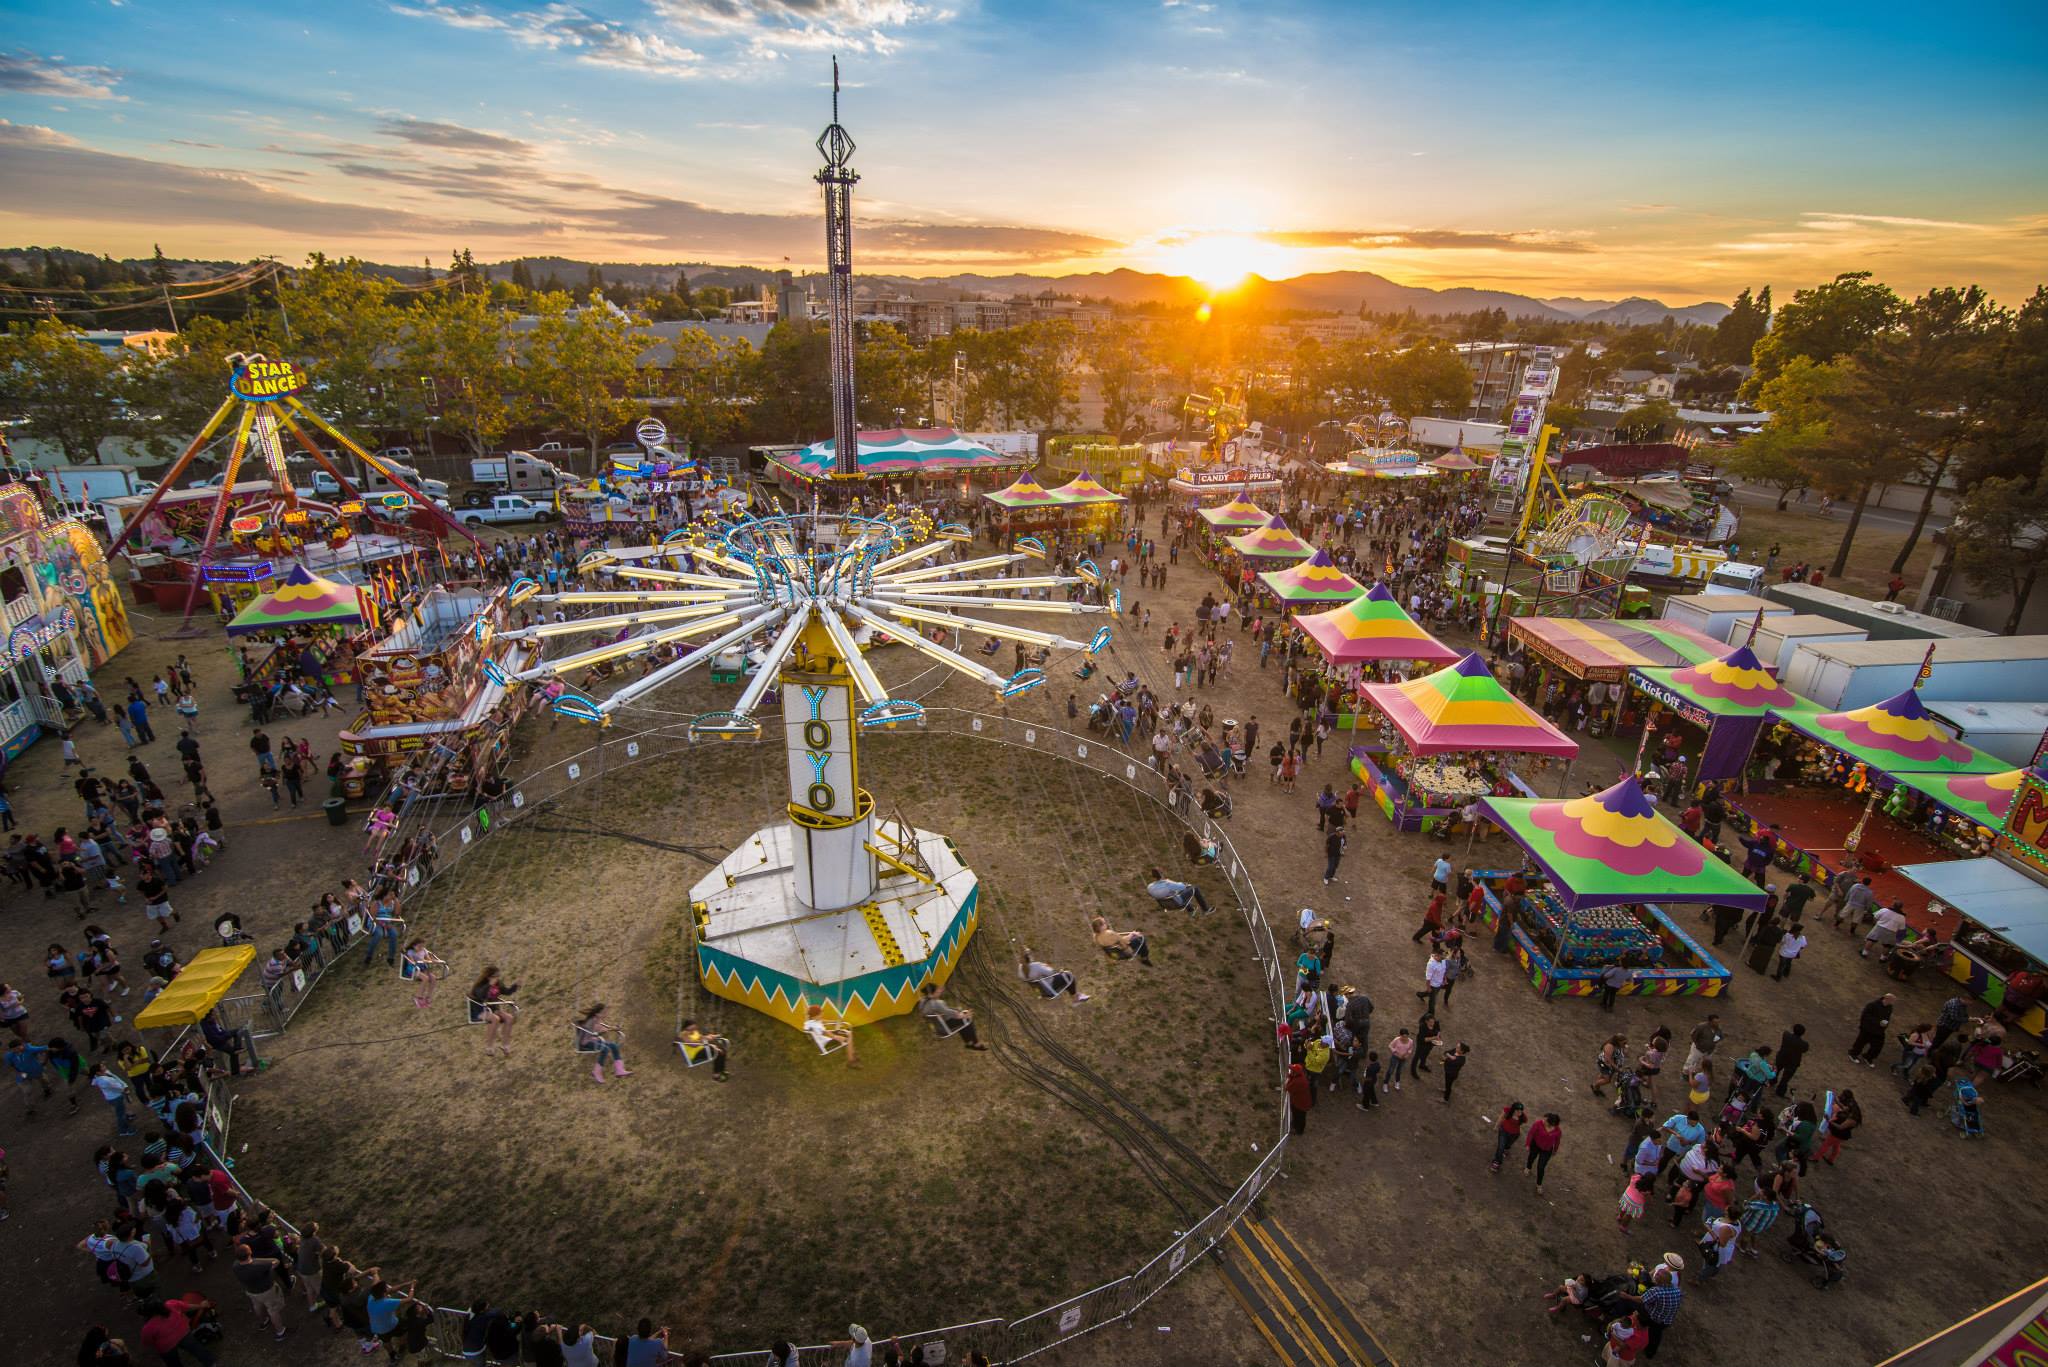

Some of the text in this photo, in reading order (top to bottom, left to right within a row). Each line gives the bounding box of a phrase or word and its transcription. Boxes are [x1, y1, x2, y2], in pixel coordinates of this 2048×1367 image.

[248, 362, 293, 379] STAR
[239, 372, 308, 395] DANCER
[1201, 474, 1230, 482] CANDY
[1640, 678, 1681, 708] Kick Off
[801, 686, 835, 811] YOYO
